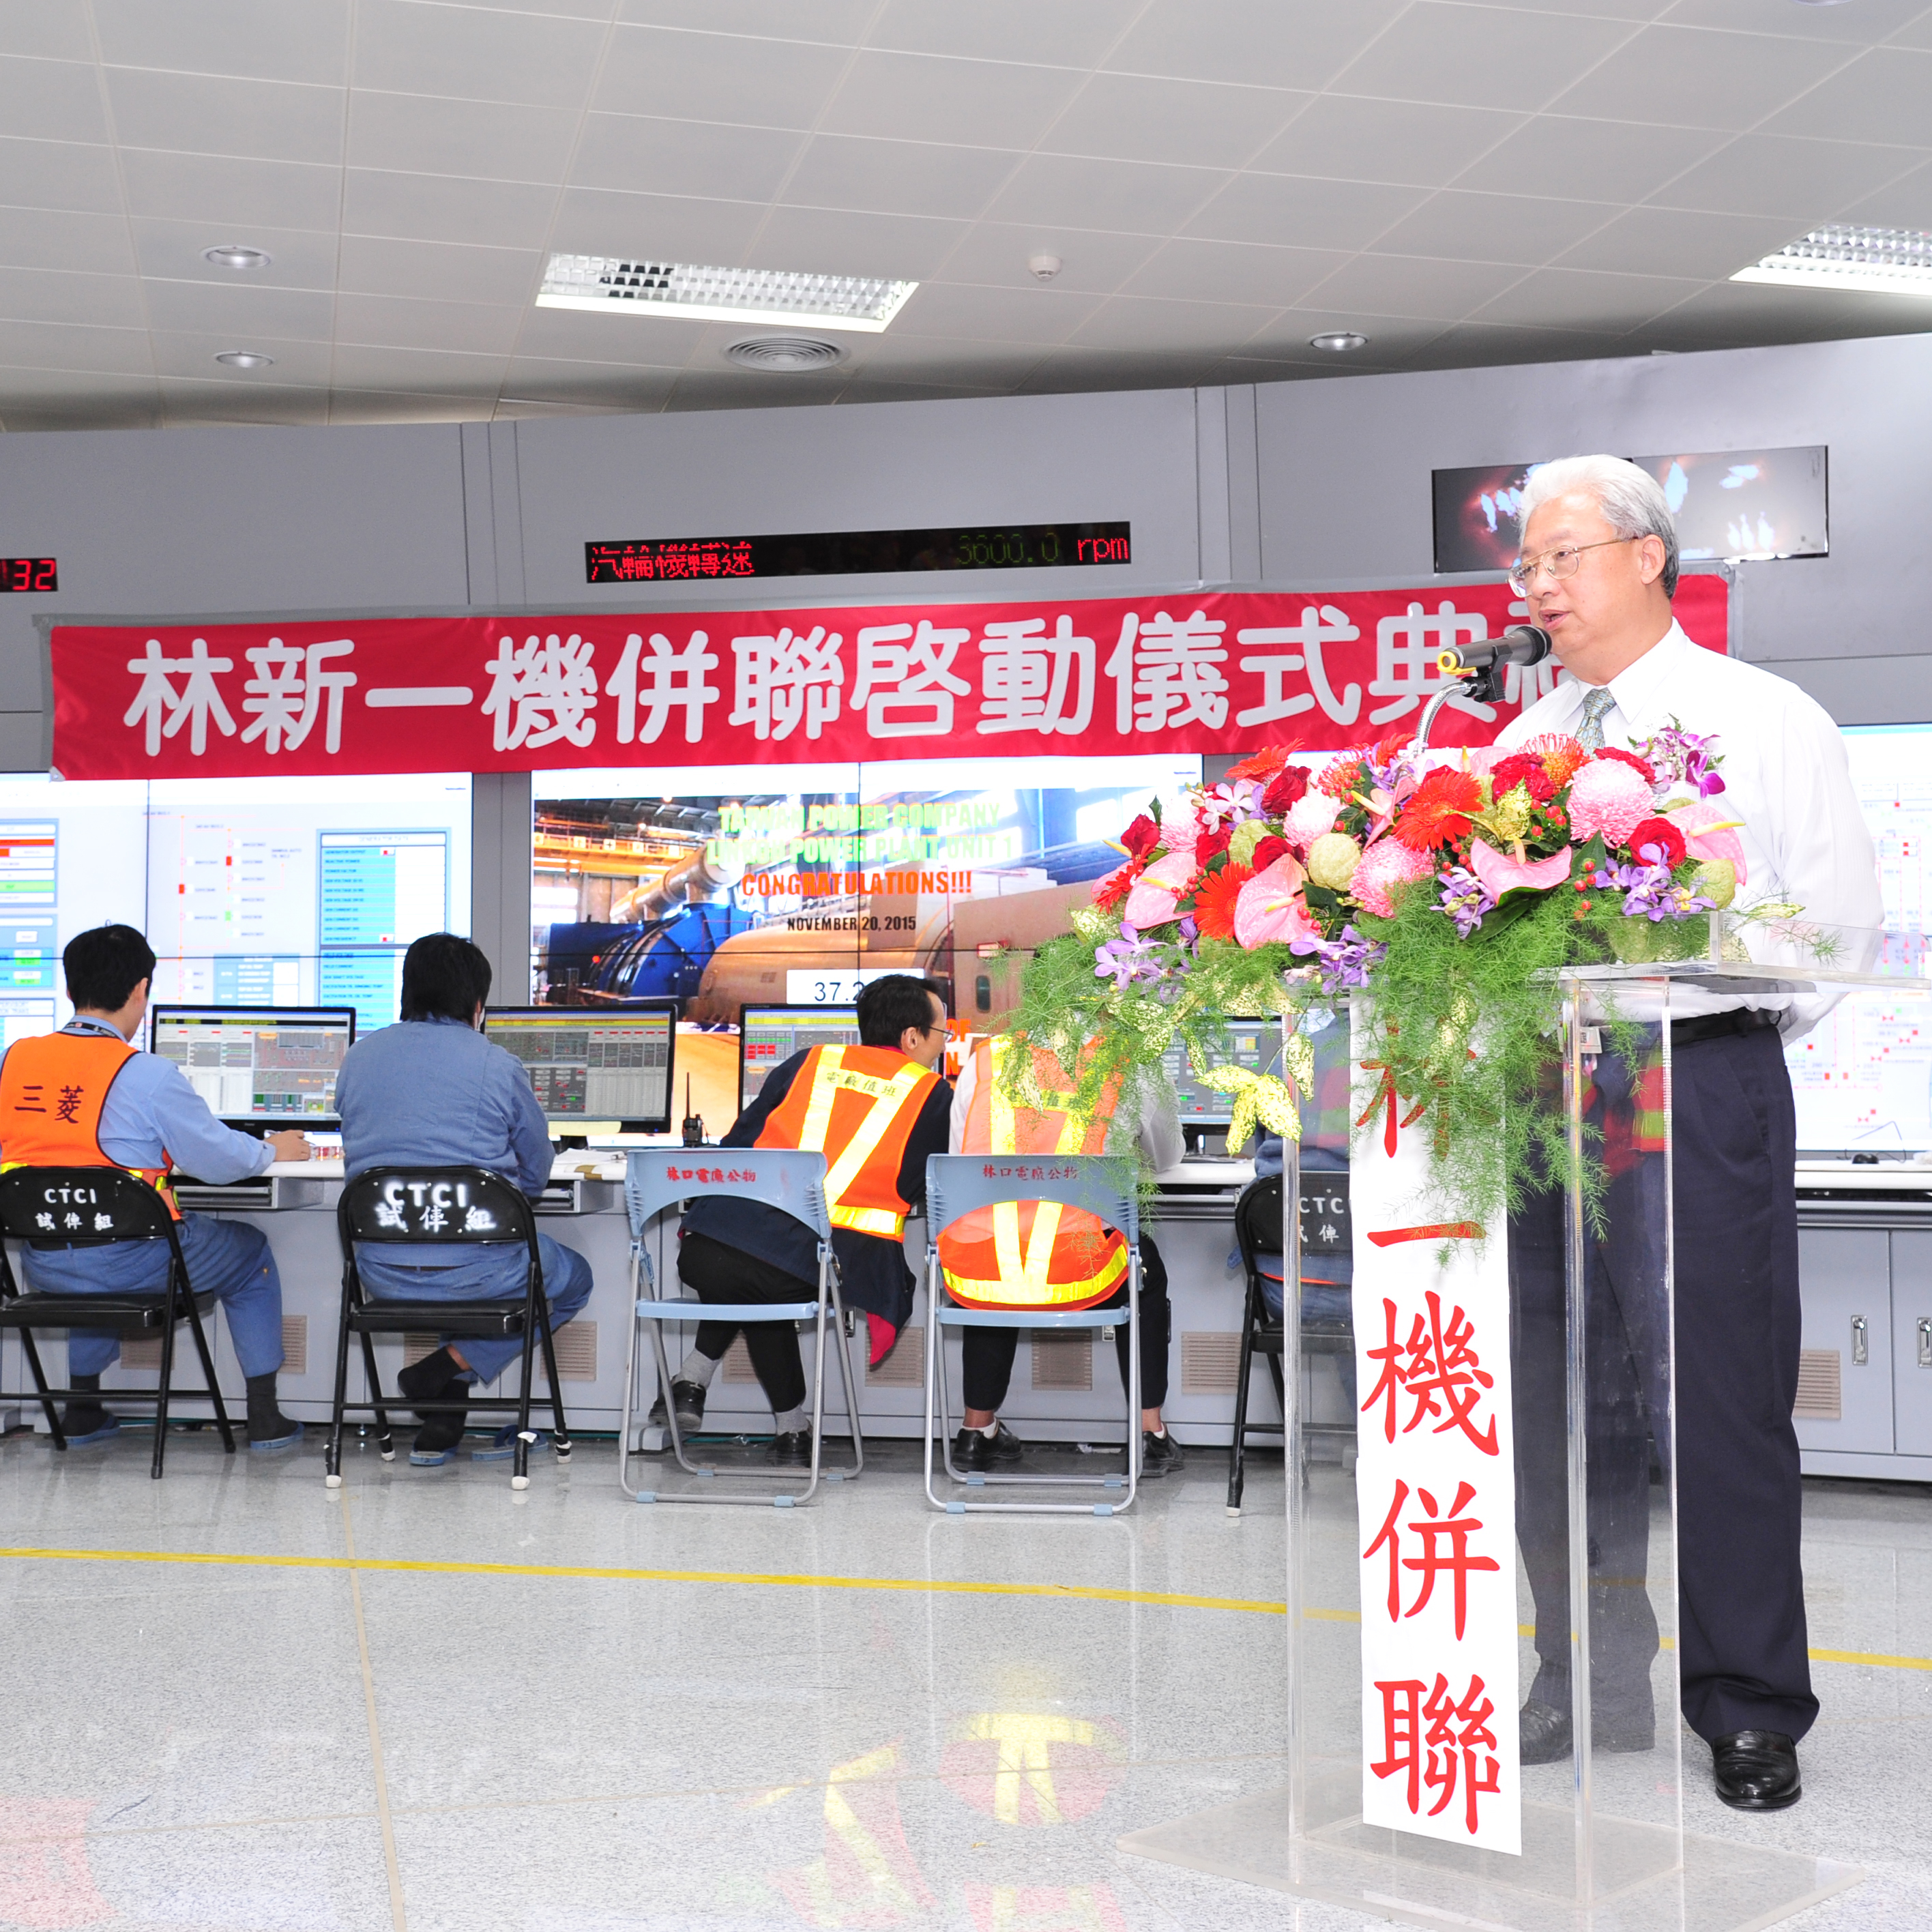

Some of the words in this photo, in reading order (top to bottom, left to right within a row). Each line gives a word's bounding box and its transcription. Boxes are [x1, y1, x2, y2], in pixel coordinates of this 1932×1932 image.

[1077, 538, 1128, 562] rpm
[718, 806, 806, 833] TAIWAN
[808, 804, 888, 831] POWER
[892, 802, 1000, 829] COMPANY
[789, 836, 868, 864] POWER
[874, 834, 942, 862] PLANT
[945, 834, 997, 860] UNIT
[1004, 834, 1012, 859] 1
[741, 870, 972, 896] CONGRATULATIONS!!!
[787, 916, 858, 931] NOVEMBER
[862, 916, 881, 933] 20,
[886, 916, 916, 931] 2015
[14, 1085, 84, 1124] 三菱
[44, 1188, 97, 1204] CTCI
[384, 1182, 467, 1208] CTCI
